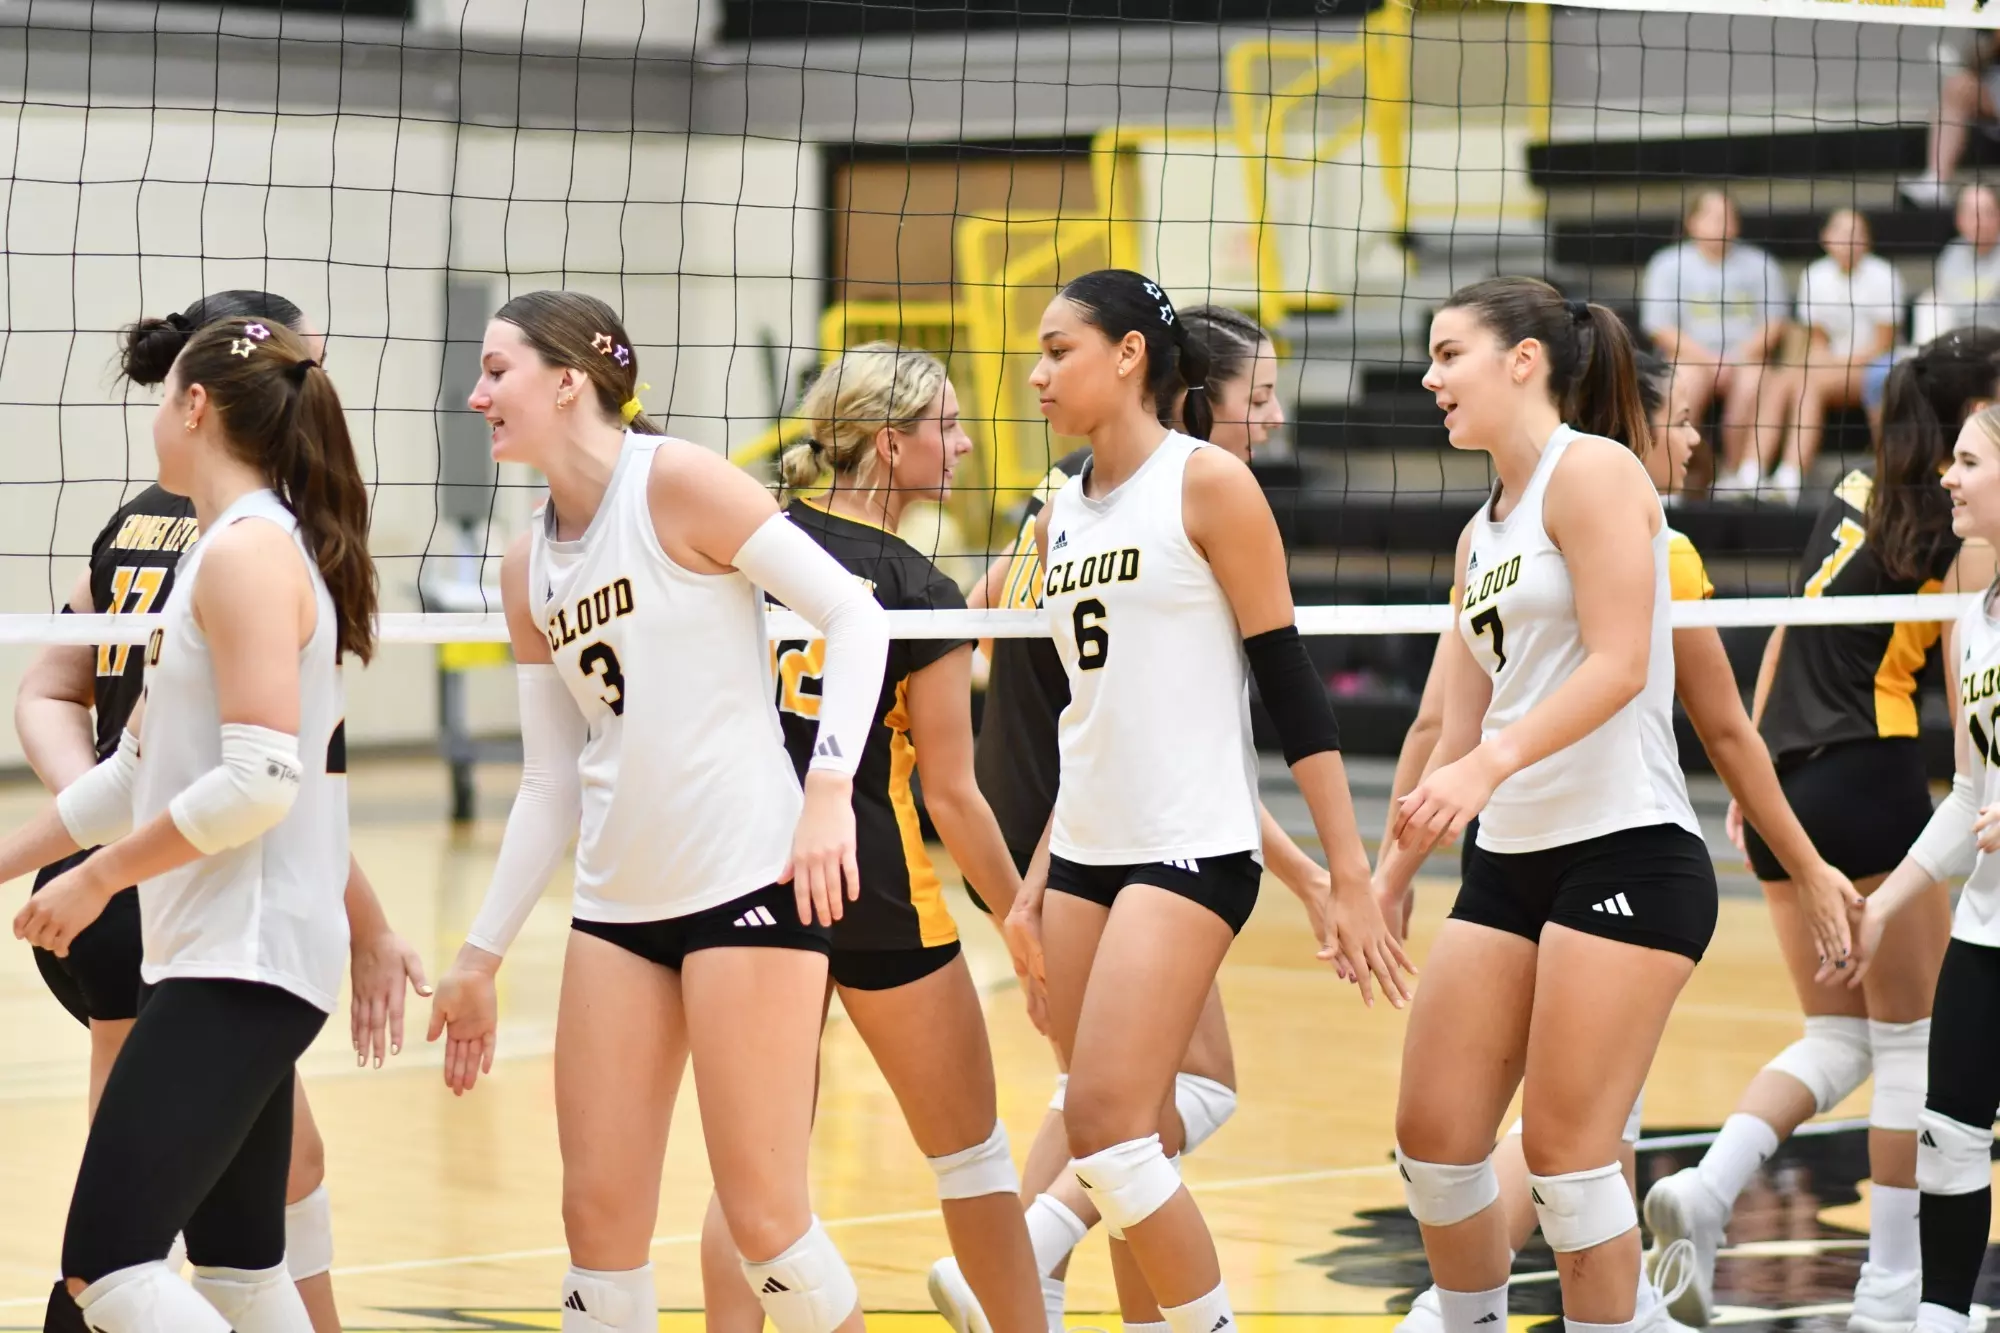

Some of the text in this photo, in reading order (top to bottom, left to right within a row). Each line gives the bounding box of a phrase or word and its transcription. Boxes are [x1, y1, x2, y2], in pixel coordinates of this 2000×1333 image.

[1046, 548, 1140, 597] CLOUD
[548, 577, 634, 652] CLOUD
[1072, 597, 1109, 671] 6
[1470, 605, 1507, 674] 7
[579, 640, 625, 717] 3
[1961, 664, 2000, 707] CLO
